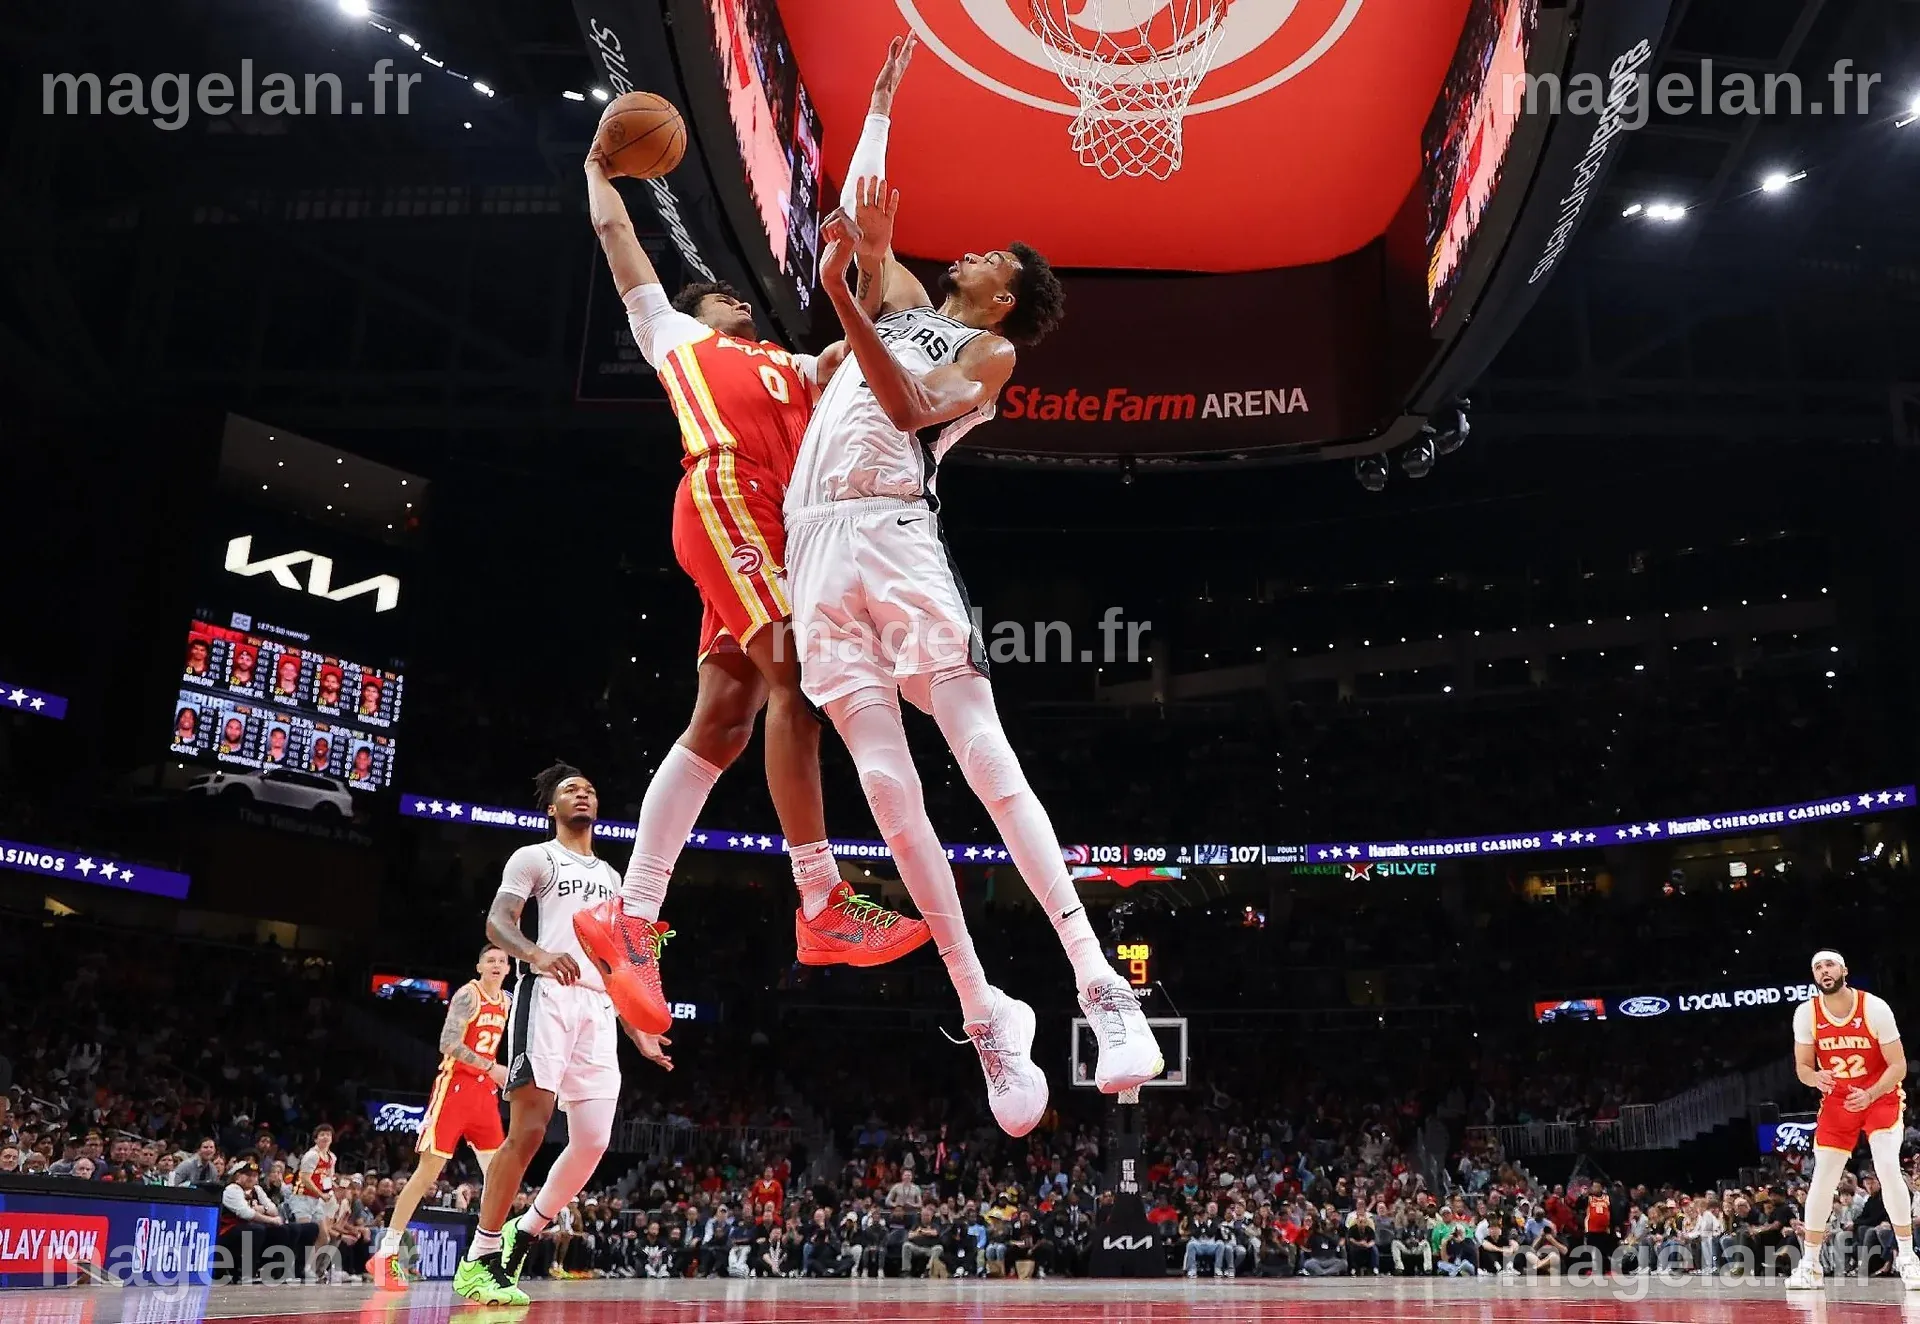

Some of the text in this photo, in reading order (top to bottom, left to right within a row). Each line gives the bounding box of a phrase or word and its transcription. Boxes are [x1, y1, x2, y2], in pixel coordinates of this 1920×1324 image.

[758, 364, 790, 404] 0
[1201, 387, 1309, 419] ARENA
[1712, 811, 1784, 830] CHEROKEE
[1788, 801, 1851, 821] CASINOS
[593, 824, 637, 839] CASIN
[0, 846, 65, 872] ASINOS
[1091, 846, 1122, 863] 103
[1133, 846, 1166, 862] 9:09
[1230, 846, 1260, 863] 107
[1411, 842, 1477, 857] CHEROKEE
[1481, 836, 1541, 852] CASINOS
[1117, 945, 1149, 960] 9:08
[1130, 960, 1147, 984] 9
[1679, 992, 1732, 1012] LOCAL
[1734, 988, 1781, 1007] FORD
[1784, 983, 1819, 1003] DEA
[1818, 1035, 1872, 1051] ATLANTA
[1829, 1053, 1868, 1079] 22
[48, 1229, 98, 1260] NOW
[146, 1219, 210, 1272] Pick'Em
